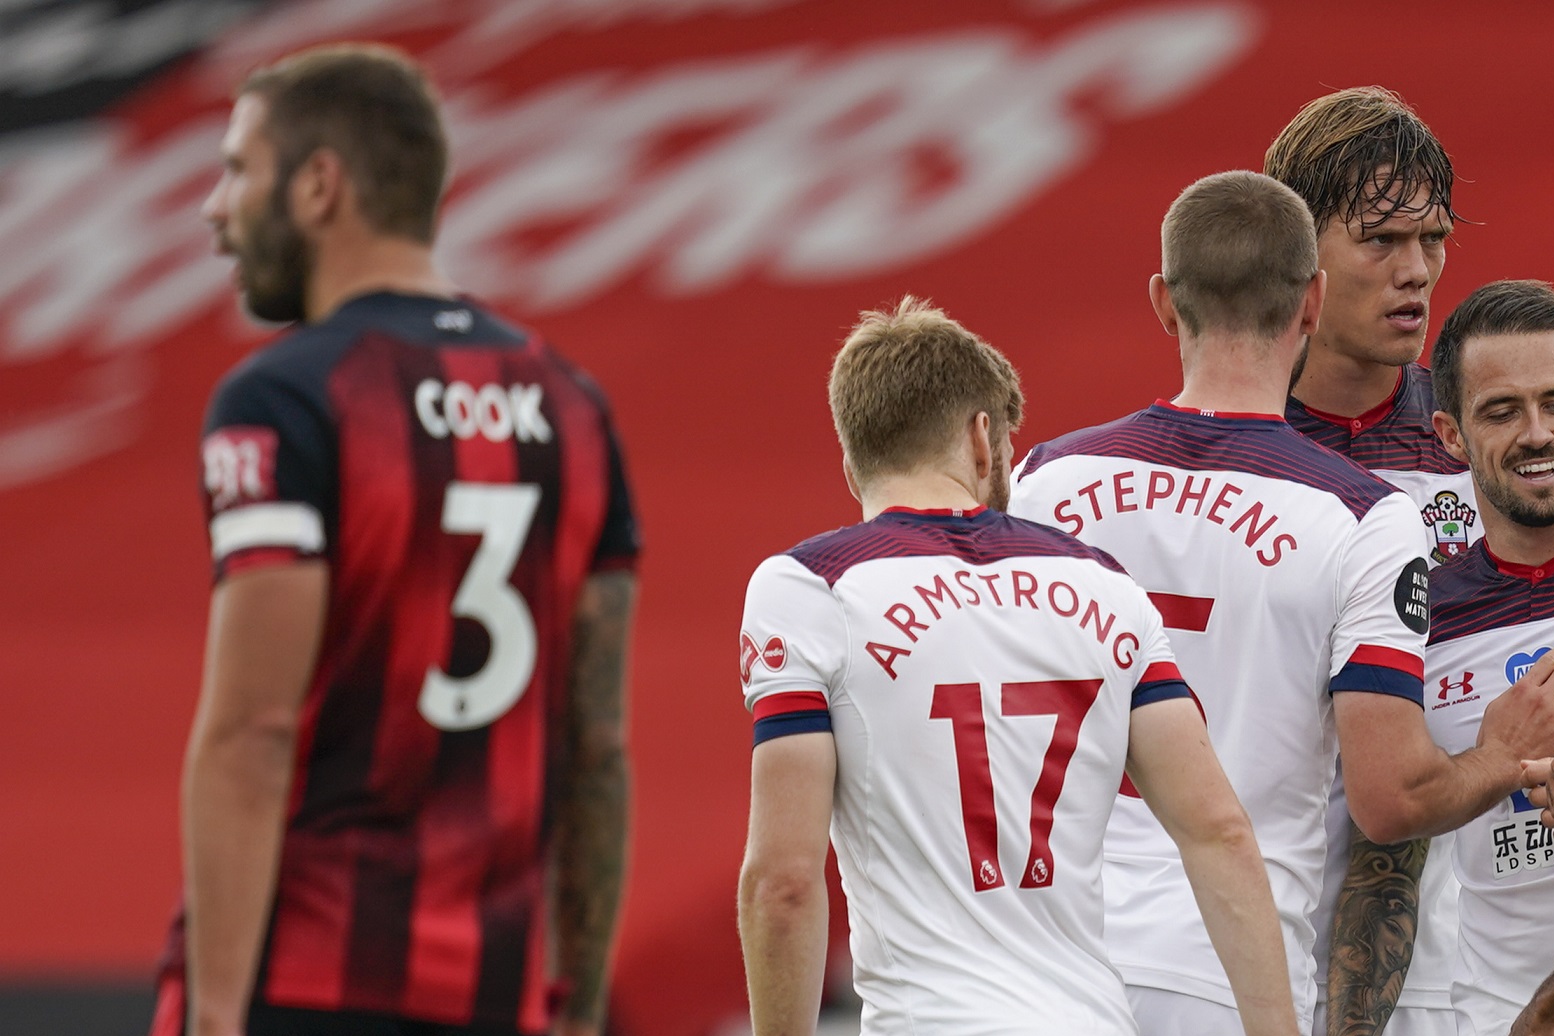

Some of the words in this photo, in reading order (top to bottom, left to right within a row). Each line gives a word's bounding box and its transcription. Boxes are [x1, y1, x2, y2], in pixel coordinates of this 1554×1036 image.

[414, 379, 552, 443] COOK
[1053, 469, 1298, 568] STEPHENS
[417, 480, 541, 731] 3
[865, 570, 1140, 682] ARMSTRONG
[1431, 702, 1451, 711] UNDER
[1452, 695, 1480, 706] ARMOUR
[929, 679, 1104, 892] 17
